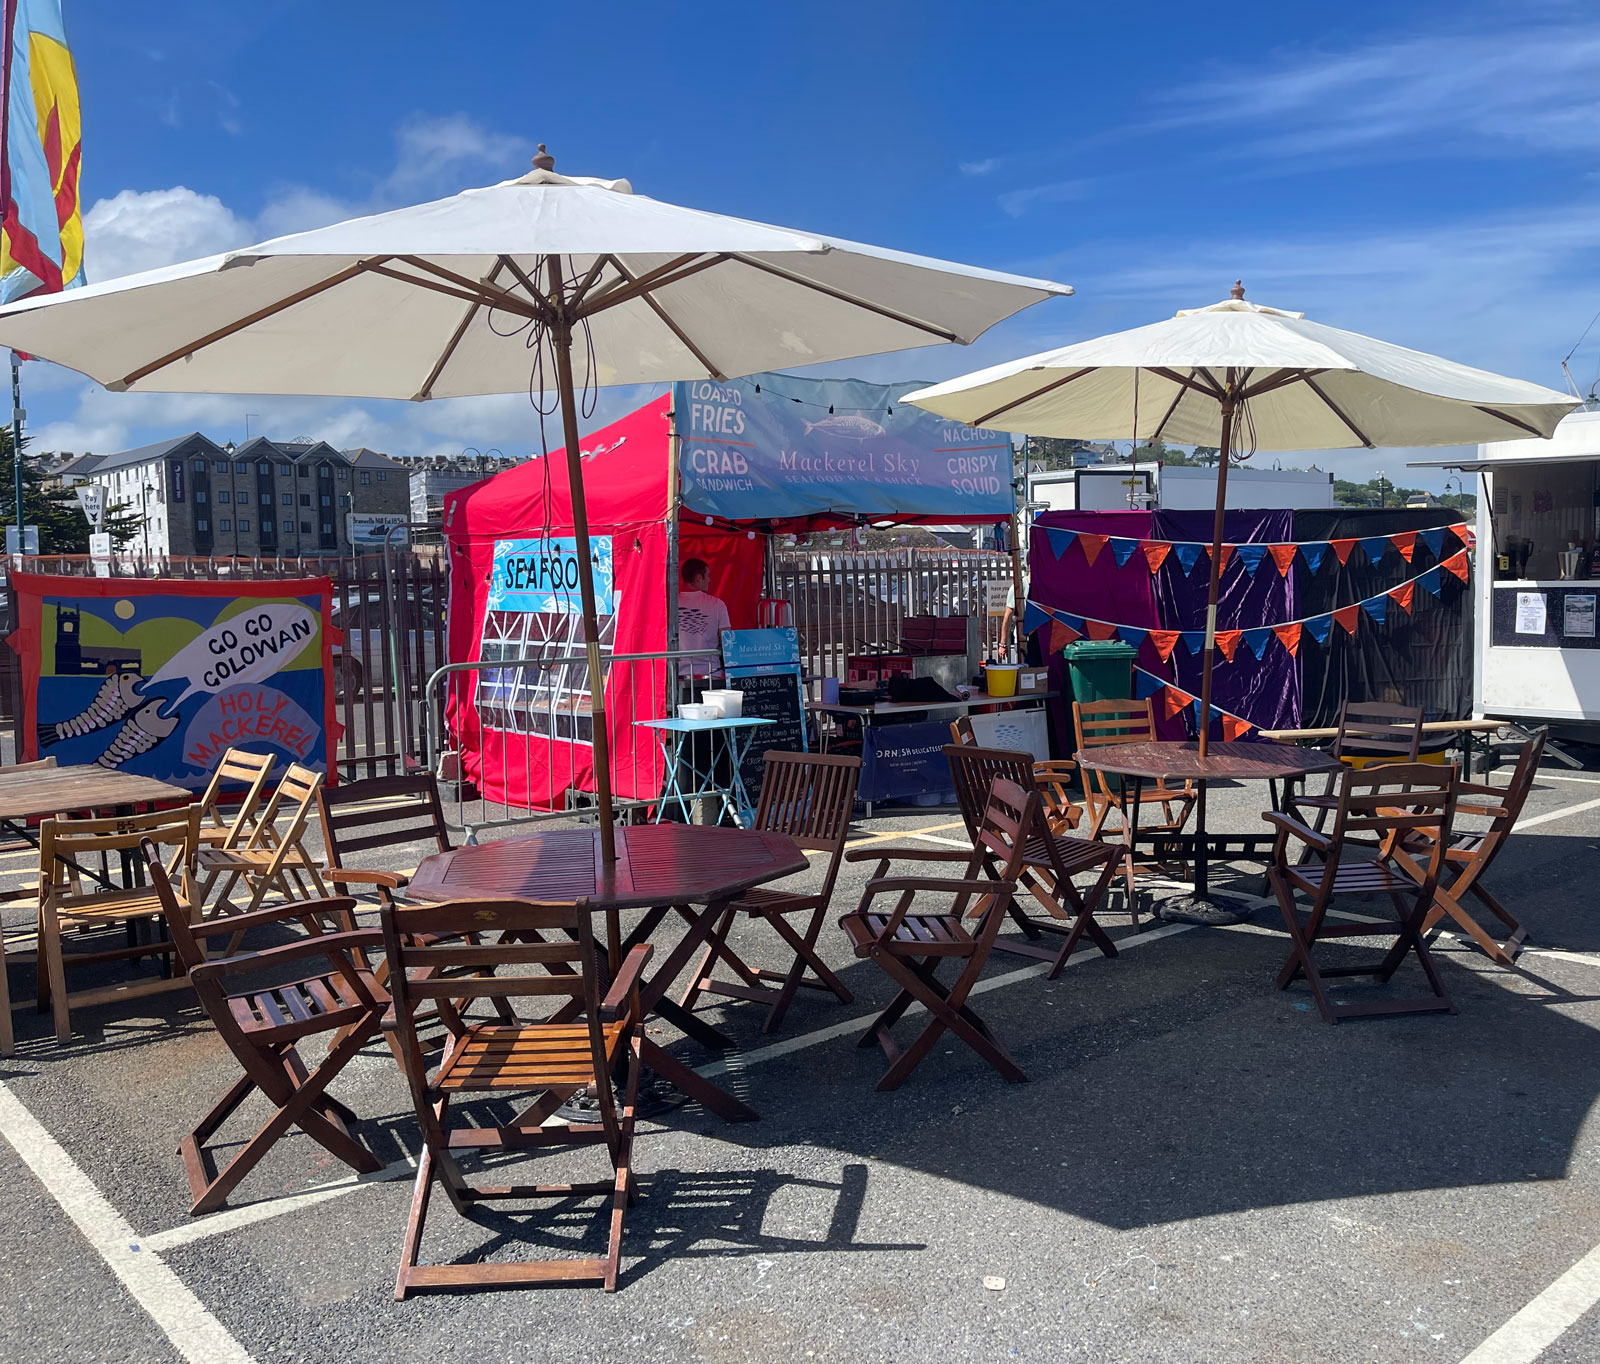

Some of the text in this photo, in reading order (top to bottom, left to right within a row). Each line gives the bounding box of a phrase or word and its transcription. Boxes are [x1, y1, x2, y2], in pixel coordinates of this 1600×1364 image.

[691, 381, 742, 406] LOADED
[691, 403, 746, 435] FRIES
[943, 427, 996, 443] NACHOS
[692, 449, 749, 475] CRAB
[780, 450, 920, 477] Mackerel Sky
[946, 454, 998, 475] CRISPY
[696, 477, 754, 492] SANDWICH
[951, 476, 1001, 497] SQUID
[84, 494, 98, 503] Pay
[84, 503, 101, 511] here
[505, 556, 579, 590] SEAFOO
[208, 613, 273, 655] GO GO
[203, 619, 311, 687] GOLOWAN
[739, 643, 772, 654] Mackerel
[773, 642, 786, 652] Sky
[219, 691, 290, 717] HOLY
[187, 714, 313, 767] MACKEREL
[911, 744, 944, 755] DELICATESS
